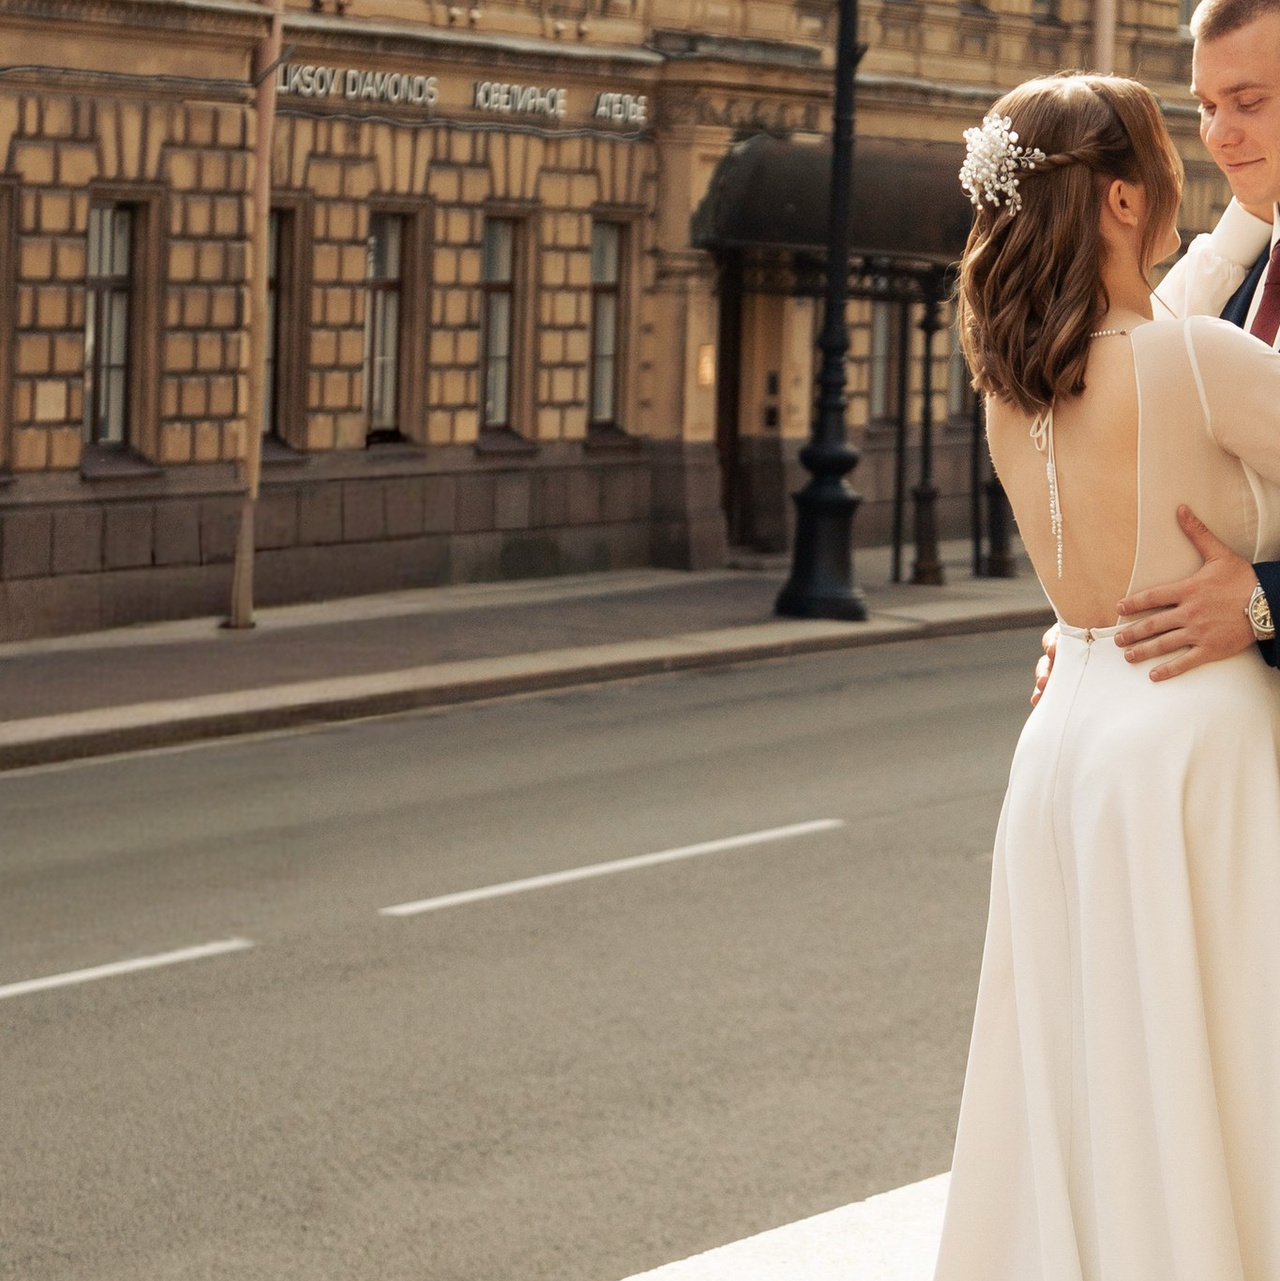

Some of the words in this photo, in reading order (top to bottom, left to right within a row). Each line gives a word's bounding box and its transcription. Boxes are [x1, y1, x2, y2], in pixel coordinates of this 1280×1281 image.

[345, 69, 439, 107] DIAMONDS
[474, 81, 568, 117] ЮВЕЛИРНОЕ
[594, 92, 648, 126] АТЕЛЬЕ
